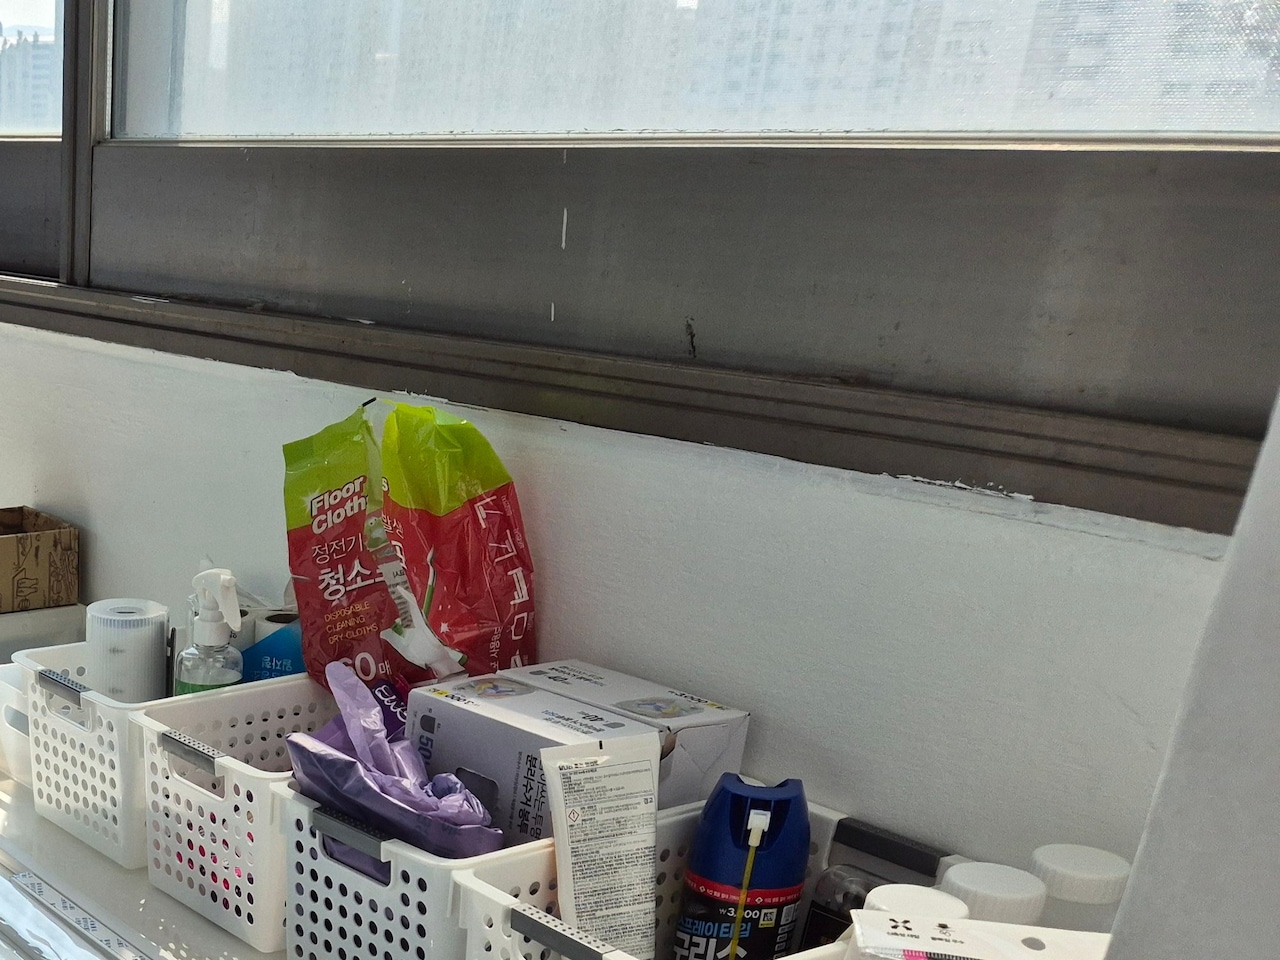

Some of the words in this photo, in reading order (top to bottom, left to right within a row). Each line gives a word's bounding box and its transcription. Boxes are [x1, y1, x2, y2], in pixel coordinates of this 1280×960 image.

[311, 476, 366, 515] Floor
[311, 533, 365, 565] 정전기
[318, 559, 384, 601] 청소
[324, 601, 370, 622] DISPOSABLE
[326, 615, 366, 634] CLEANING
[328, 632, 344, 645] DRY
[345, 623, 379, 640] CLOTHS
[519, 754, 538, 807] 분리수거
[719, 907, 760, 919] ₩3,00
